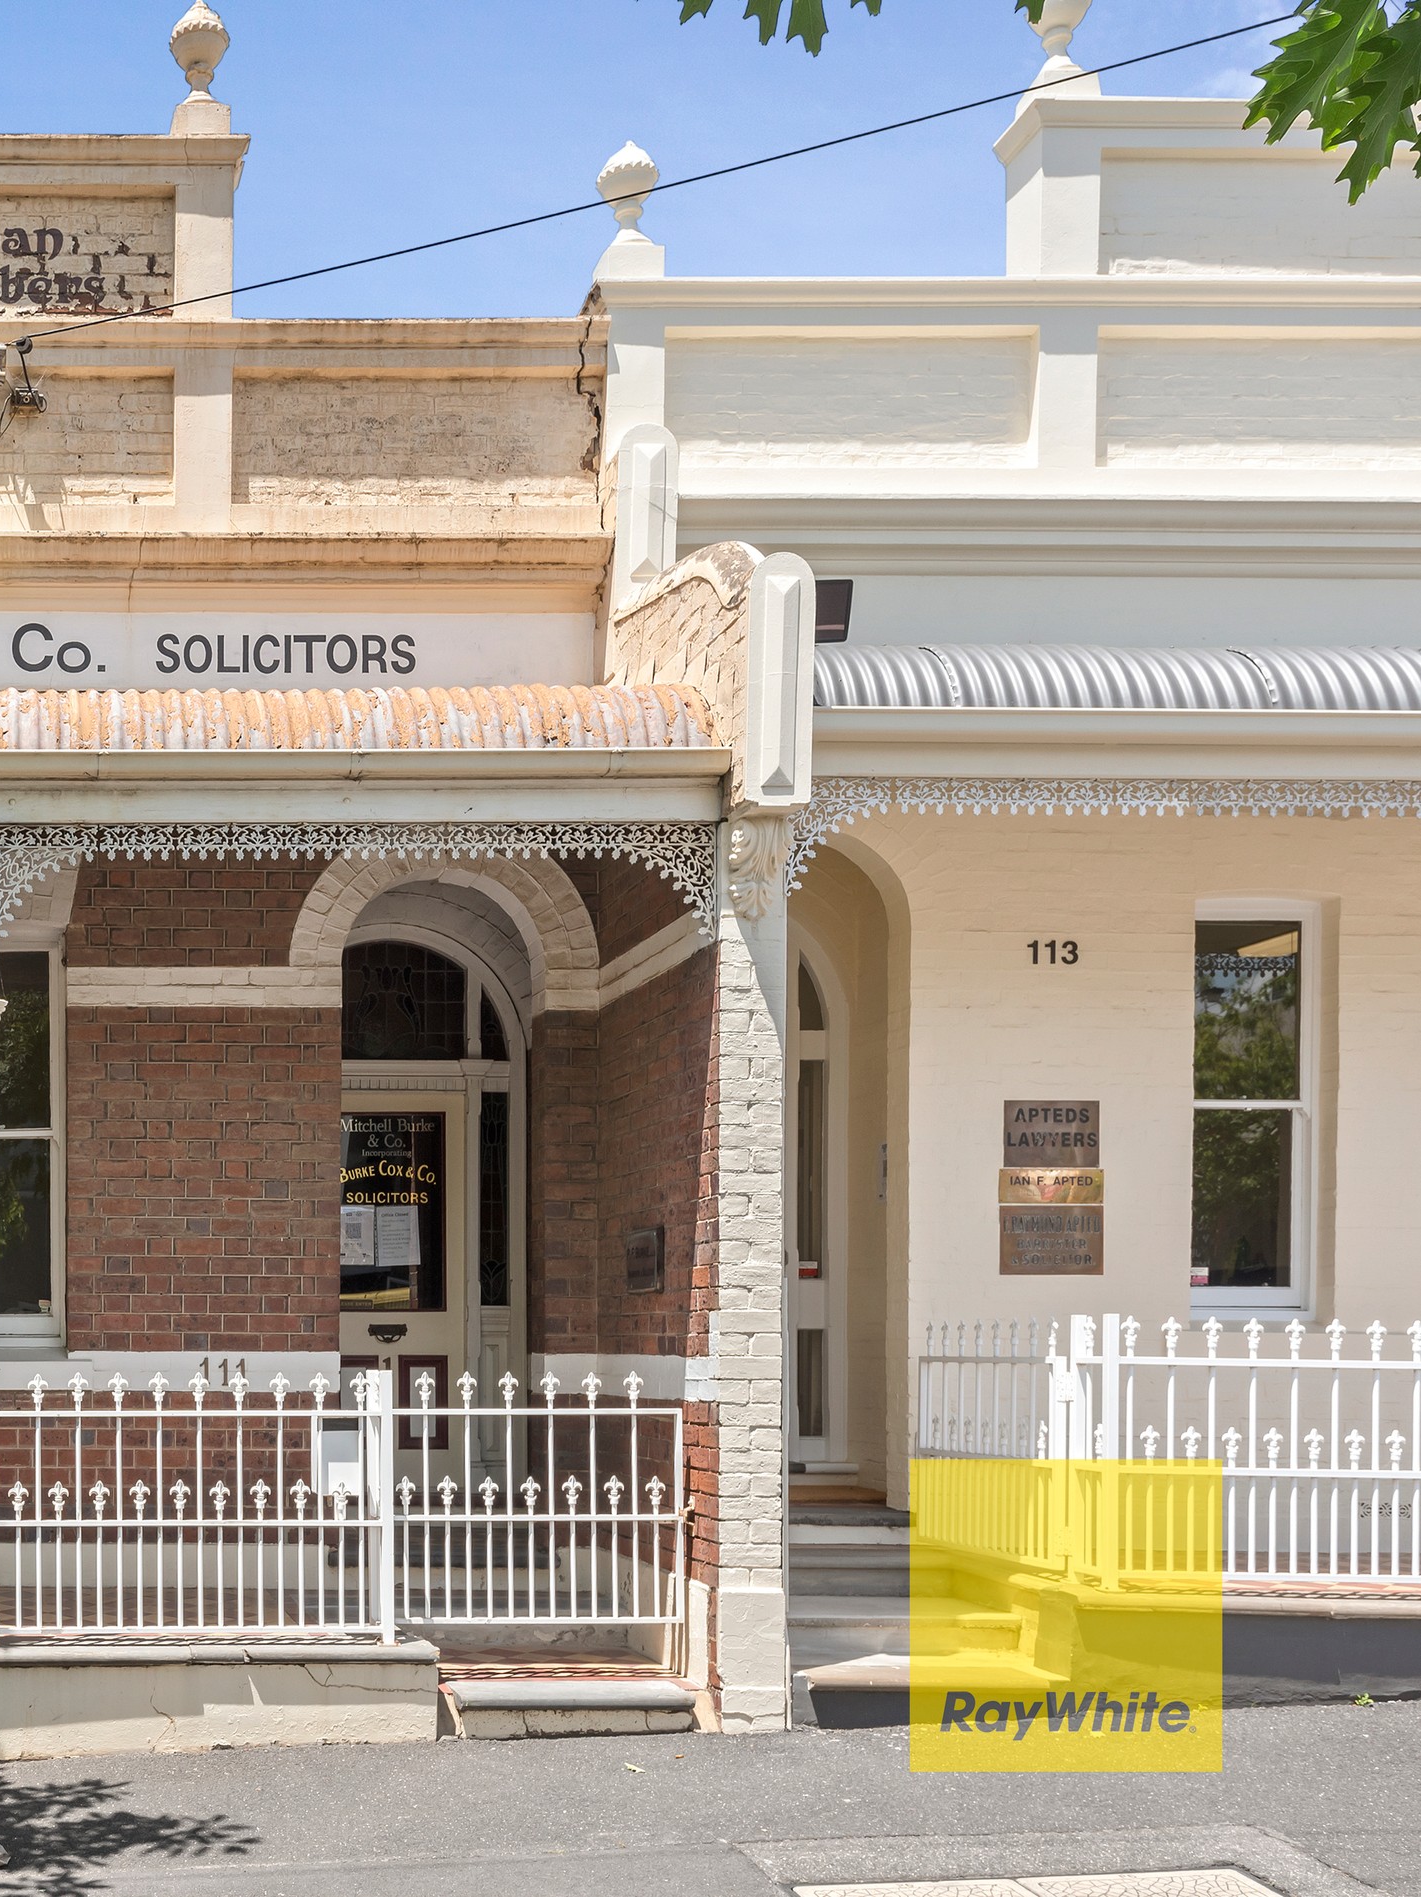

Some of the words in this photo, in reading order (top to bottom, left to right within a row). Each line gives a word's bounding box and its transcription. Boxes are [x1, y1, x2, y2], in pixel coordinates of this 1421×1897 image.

[155, 633, 417, 675] SOLICITORS
[1026, 939, 1079, 965] 113
[1014, 1107, 1090, 1124] APTEDS
[340, 1118, 392, 1133] Mitchell
[397, 1118, 435, 1133] Burke
[367, 1133, 379, 1148] &
[384, 1133, 406, 1148] Co.
[1006, 1131, 1098, 1148] LAWYERS
[361, 1149, 412, 1159] Incorporating
[405, 1166, 416, 1179] &
[1010, 1175, 1030, 1186] IAN
[1037, 1175, 1047, 1186] F.
[1053, 1175, 1094, 1186] APTED
[346, 1191, 429, 1204] SOLICITORS
[1066, 1215, 1102, 1234] APTED
[1017, 1238, 1088, 1250] BARRISTER
[199, 1357, 248, 1386] 111
